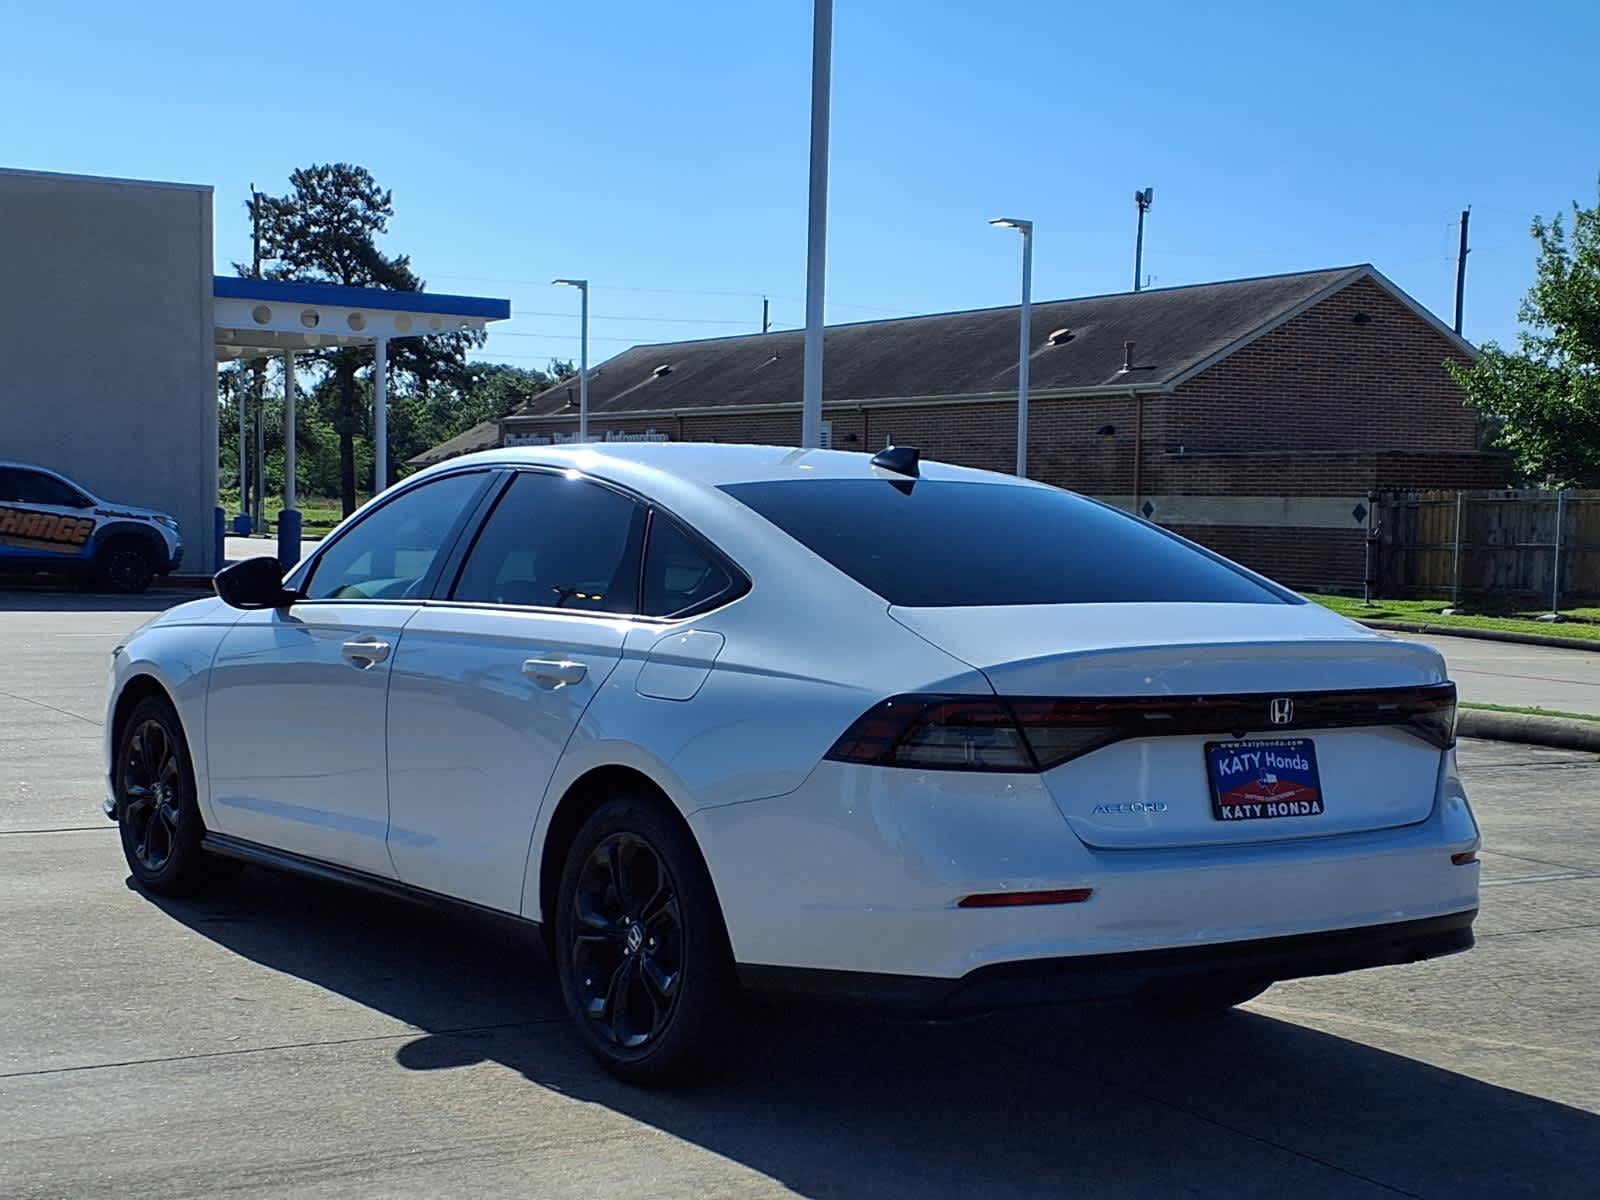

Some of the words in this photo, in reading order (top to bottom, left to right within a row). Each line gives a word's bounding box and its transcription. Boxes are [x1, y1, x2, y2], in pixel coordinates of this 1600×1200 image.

[1219, 751, 1262, 776] KATY
[1265, 751, 1309, 771] Honda
[1092, 802, 1168, 814] ACCORD
[1221, 804, 1262, 819] KATY
[1267, 801, 1321, 817] HONDA
